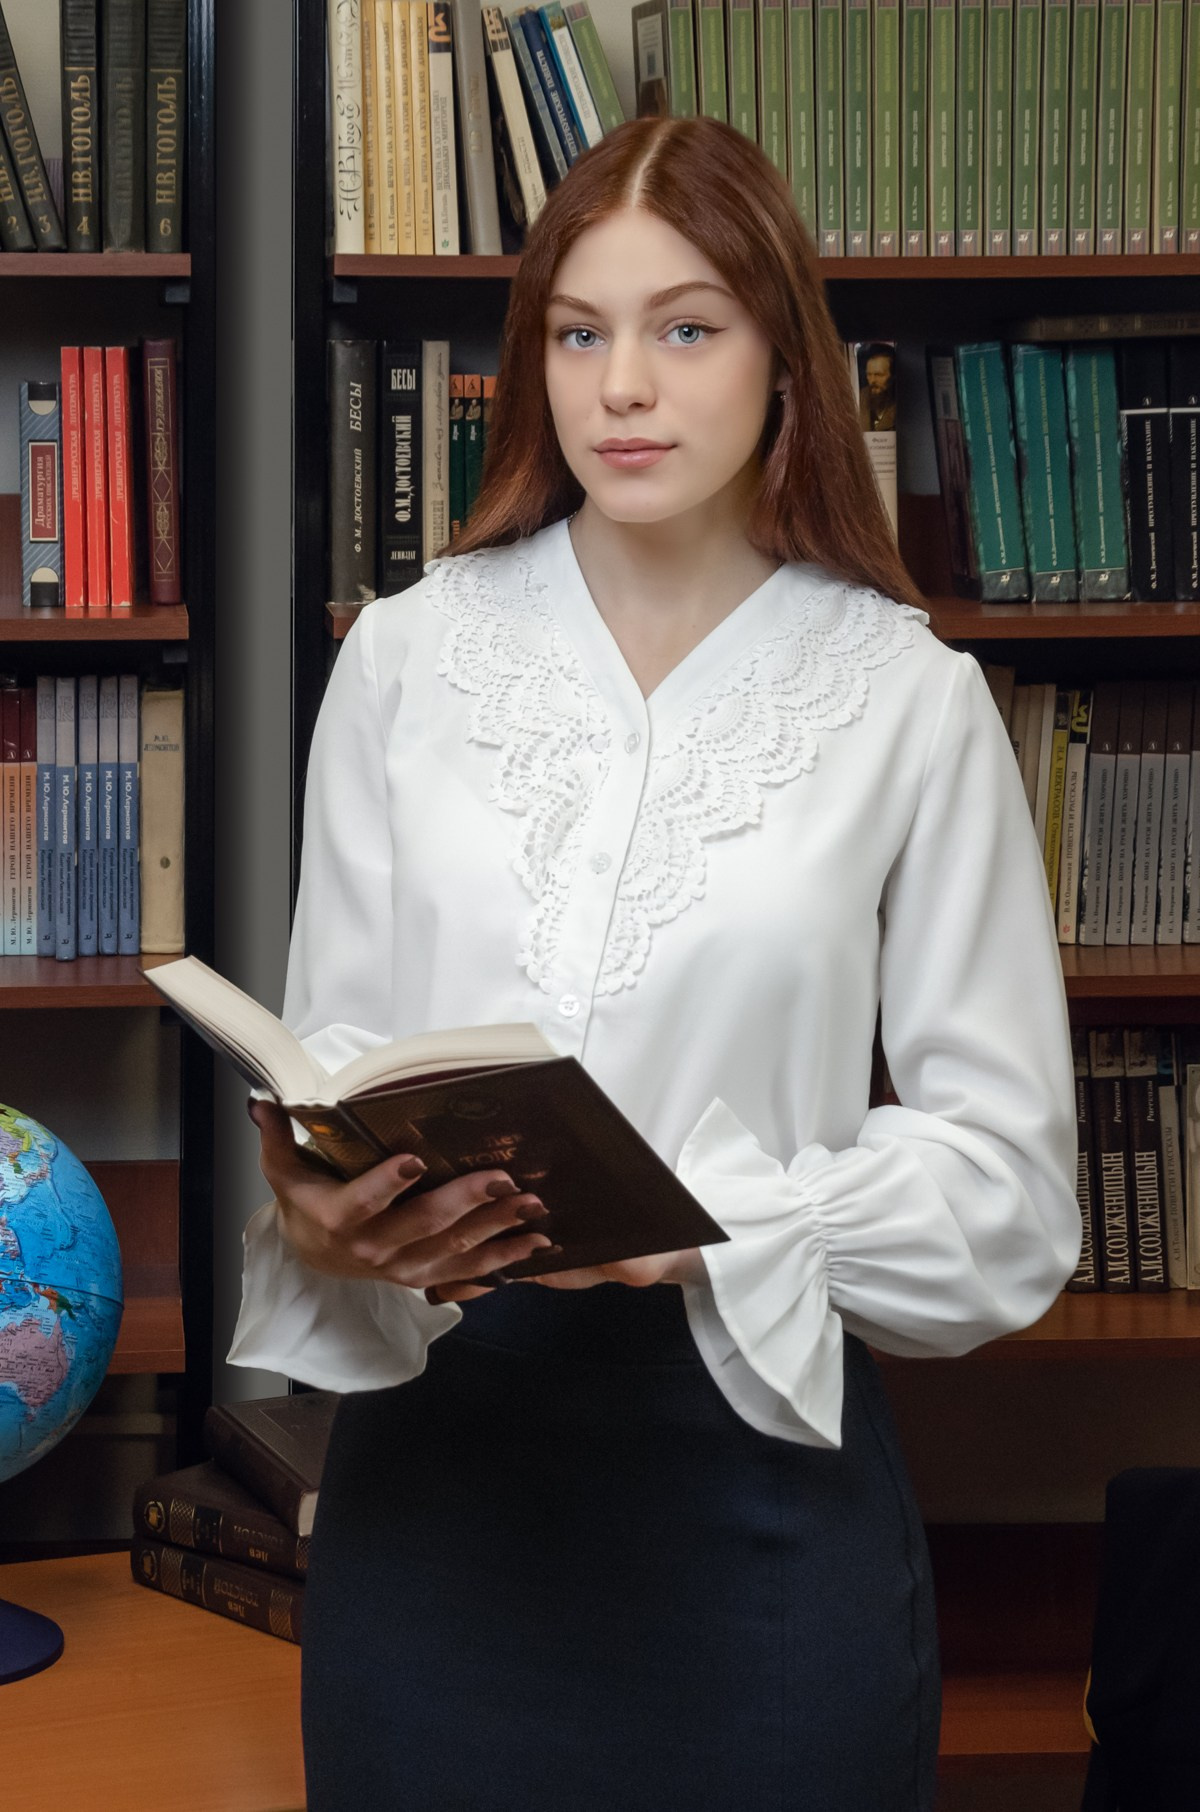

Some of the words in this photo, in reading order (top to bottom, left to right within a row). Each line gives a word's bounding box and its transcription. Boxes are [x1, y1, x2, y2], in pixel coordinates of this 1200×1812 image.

[536, 49, 555, 89] ПОВЕСТИ
[71, 74, 91, 165] ГОГОЛЬ
[156, 75, 177, 167] ГОГОЛЬ
[550, 90, 578, 157] ПЕТЕРБУРГСКИЕ
[386, 141, 394, 153] НА
[420, 136, 428, 148] НА
[435, 147, 443, 159] НА
[387, 158, 395, 188] ВЕЧЕРА
[436, 162, 444, 191] ВЕЧЕРА
[442, 145, 451, 190] ДИКАНЬКИ
[38, 215, 50, 233] 3
[77, 216, 90, 235] 4
[159, 218, 171, 236] 6
[69, 374, 77, 426] ЛИТЕРАТУРА
[92, 373, 101, 426] ЛИТЕРАТУРА
[391, 369, 416, 390] БЕСЫ
[113, 375, 122, 427] ЛИТЕРАТУРА
[350, 382, 362, 432] БЕСЫ
[1145, 420, 1153, 461] НАКАЗАНИЕ
[70, 431, 80, 502] ДРЕВНЕРУССКАЯ
[94, 430, 104, 502] ДРЕВНЕРУССКАЯ
[115, 431, 125, 502] ДРЕВНЕРУССКАЯ
[354, 448, 362, 523] ДОСТОЕВСКИЙ
[35, 457, 45, 527] Драматургия
[1147, 472, 1155, 527] ПРЕСТУПЛЕНИЕ
[355, 527, 362, 538] М.
[355, 541, 362, 553] Ф.
[1069, 771, 1078, 812] РАССКАЗЫ
[1097, 849, 1103, 859] НА
[1100, 769, 1108, 801] ХОРОШО
[1067, 823, 1075, 859] ПОВЕСТИ
[1171, 848, 1177, 858] НА
[1077, 1082, 1086, 1123] Рассказы
[1113, 1081, 1122, 1123] Рассказы
[1146, 1080, 1155, 1122] Рассказы
